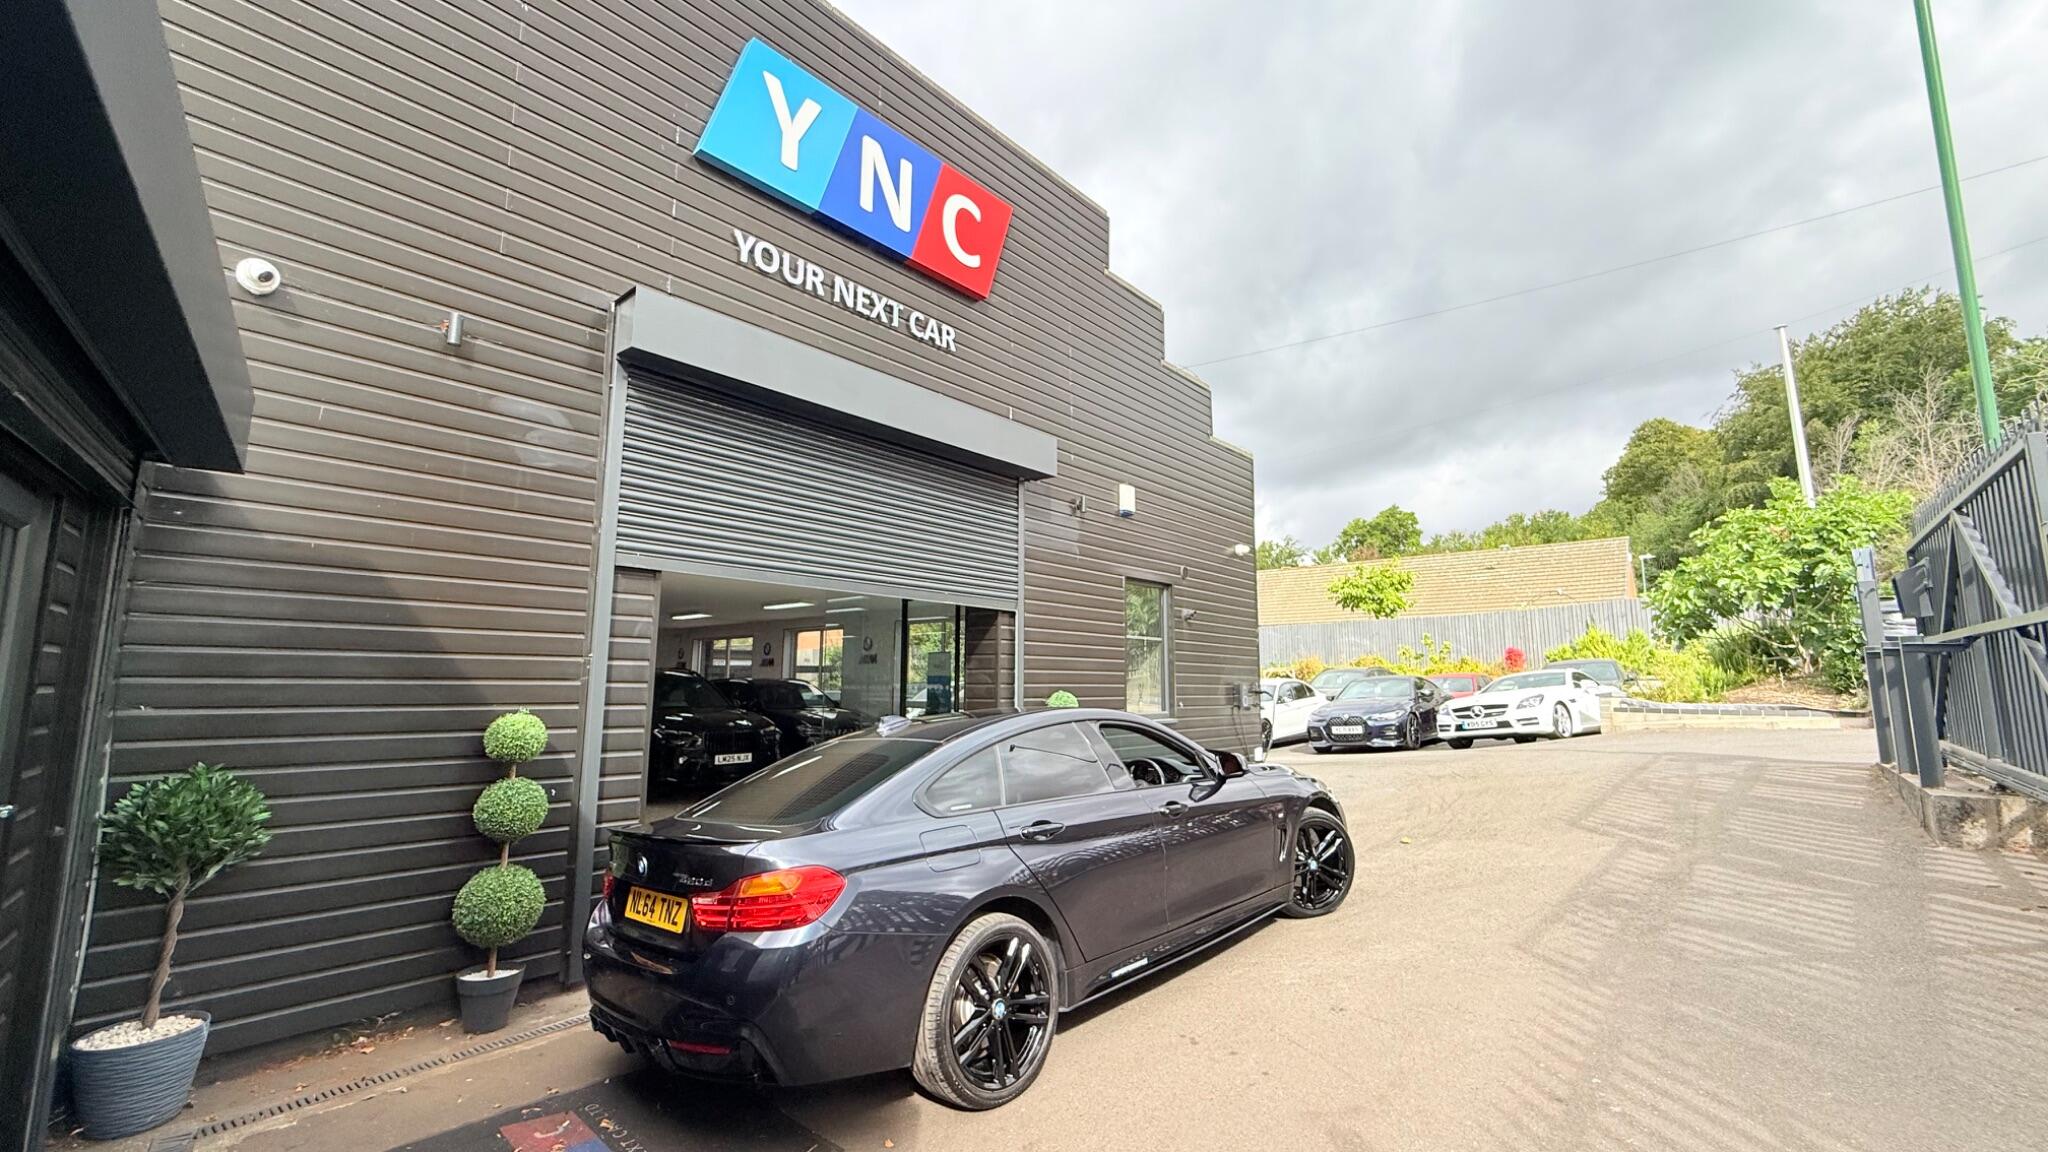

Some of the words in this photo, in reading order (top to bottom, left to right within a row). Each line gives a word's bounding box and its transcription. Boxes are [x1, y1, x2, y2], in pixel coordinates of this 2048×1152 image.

[763, 70, 982, 268] YNC
[733, 228, 824, 297] YOUR
[833, 274, 904, 328] NEXT
[909, 310, 957, 352] CAR
[630, 889, 657, 918] NL64
[658, 897, 682, 926] TNZ
